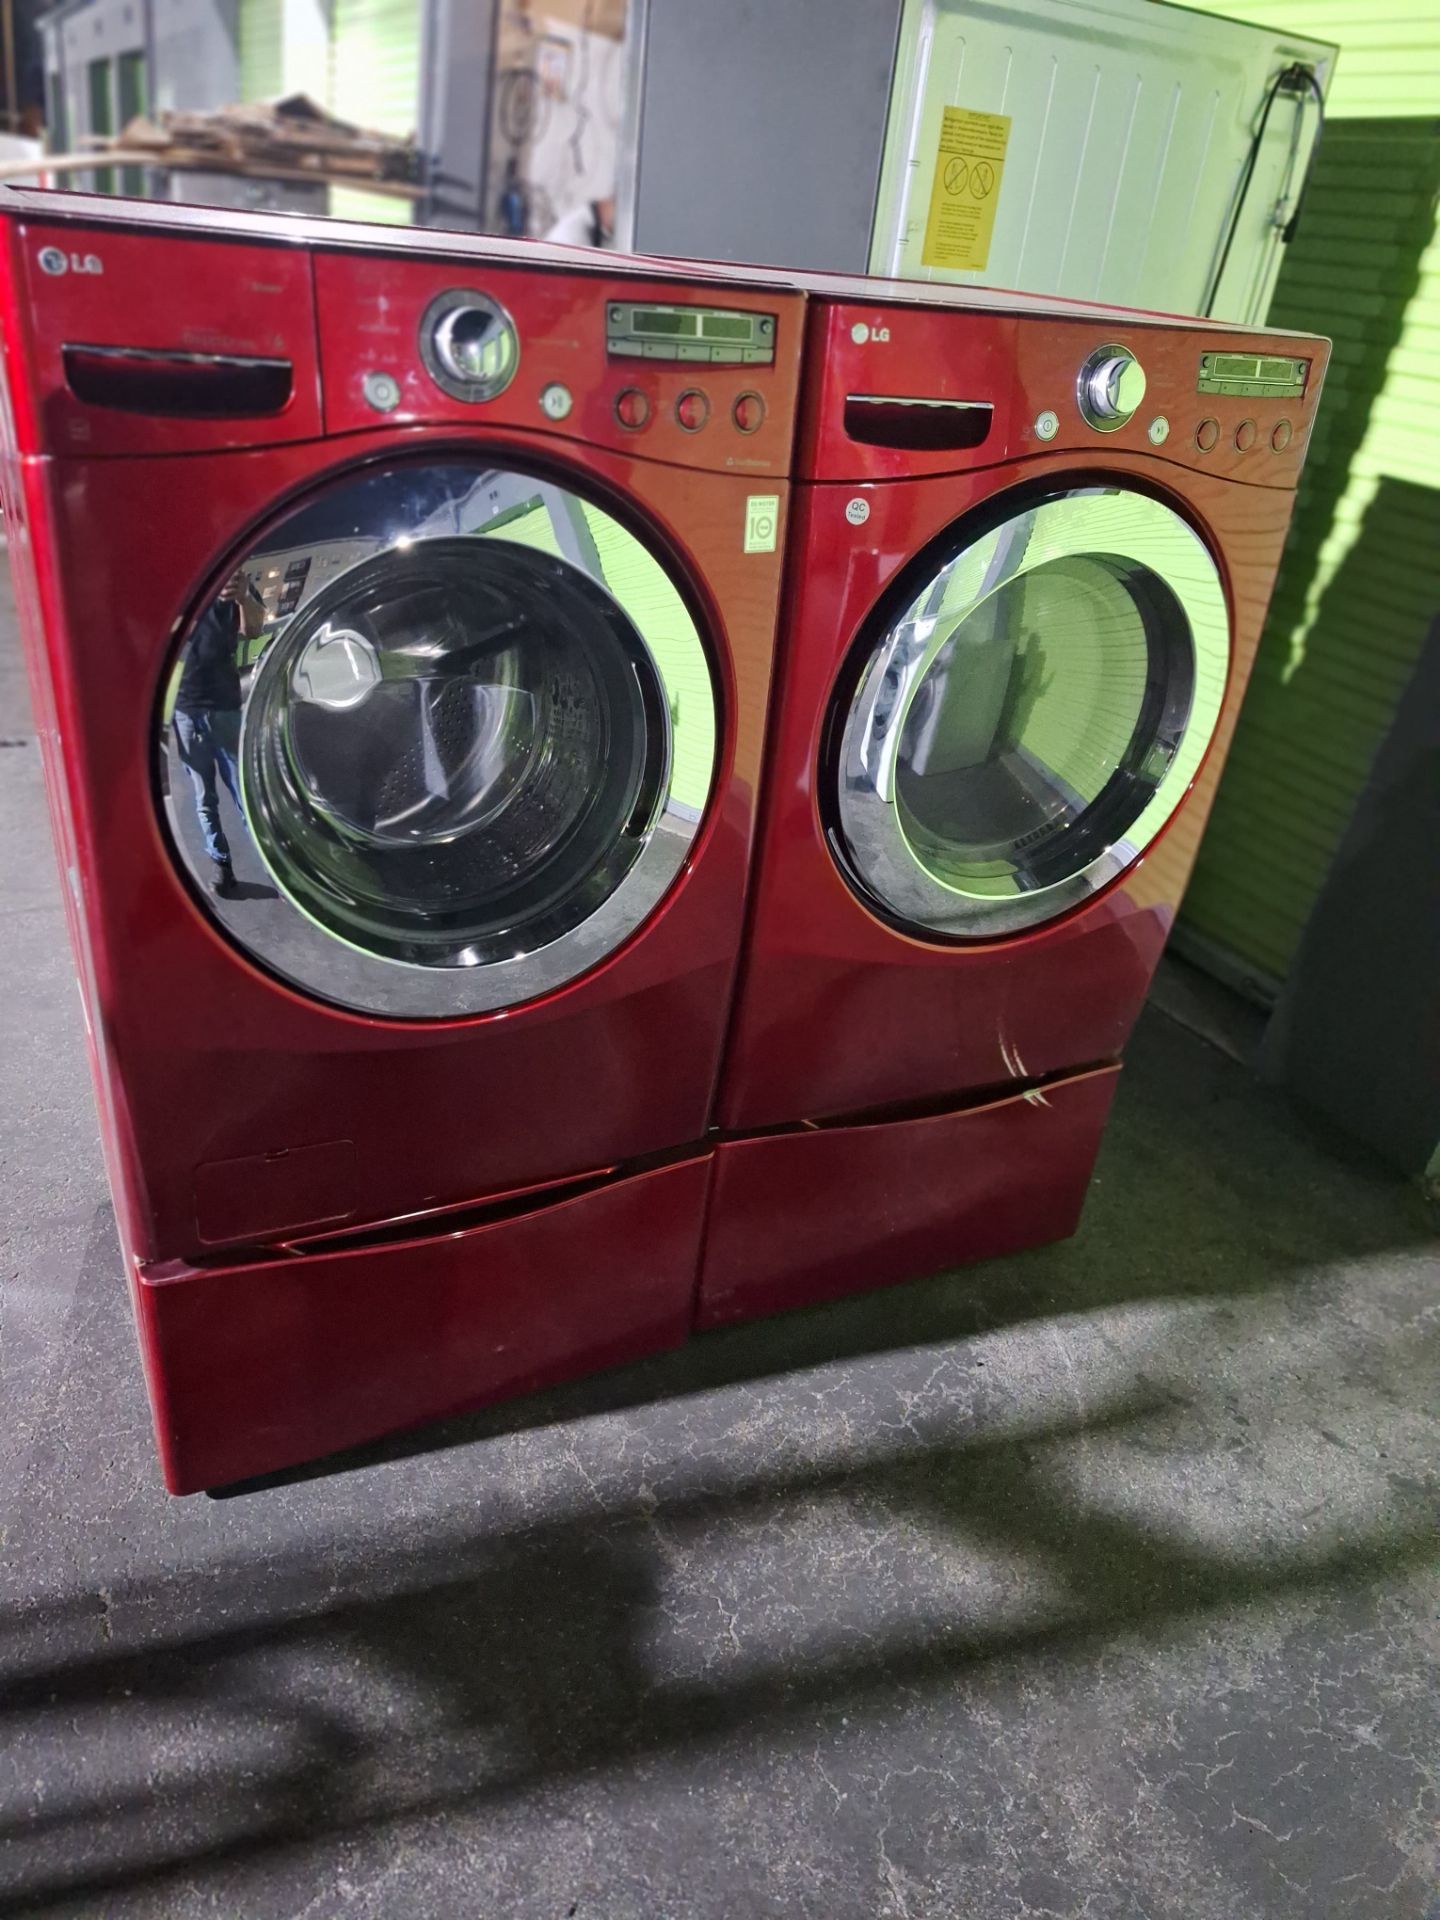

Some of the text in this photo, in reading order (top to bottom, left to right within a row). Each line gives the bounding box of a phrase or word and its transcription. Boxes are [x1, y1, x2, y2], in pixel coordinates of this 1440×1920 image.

[70, 252, 103, 274] LG
[871, 327, 890, 342] LG
[852, 501, 866, 512] QC
